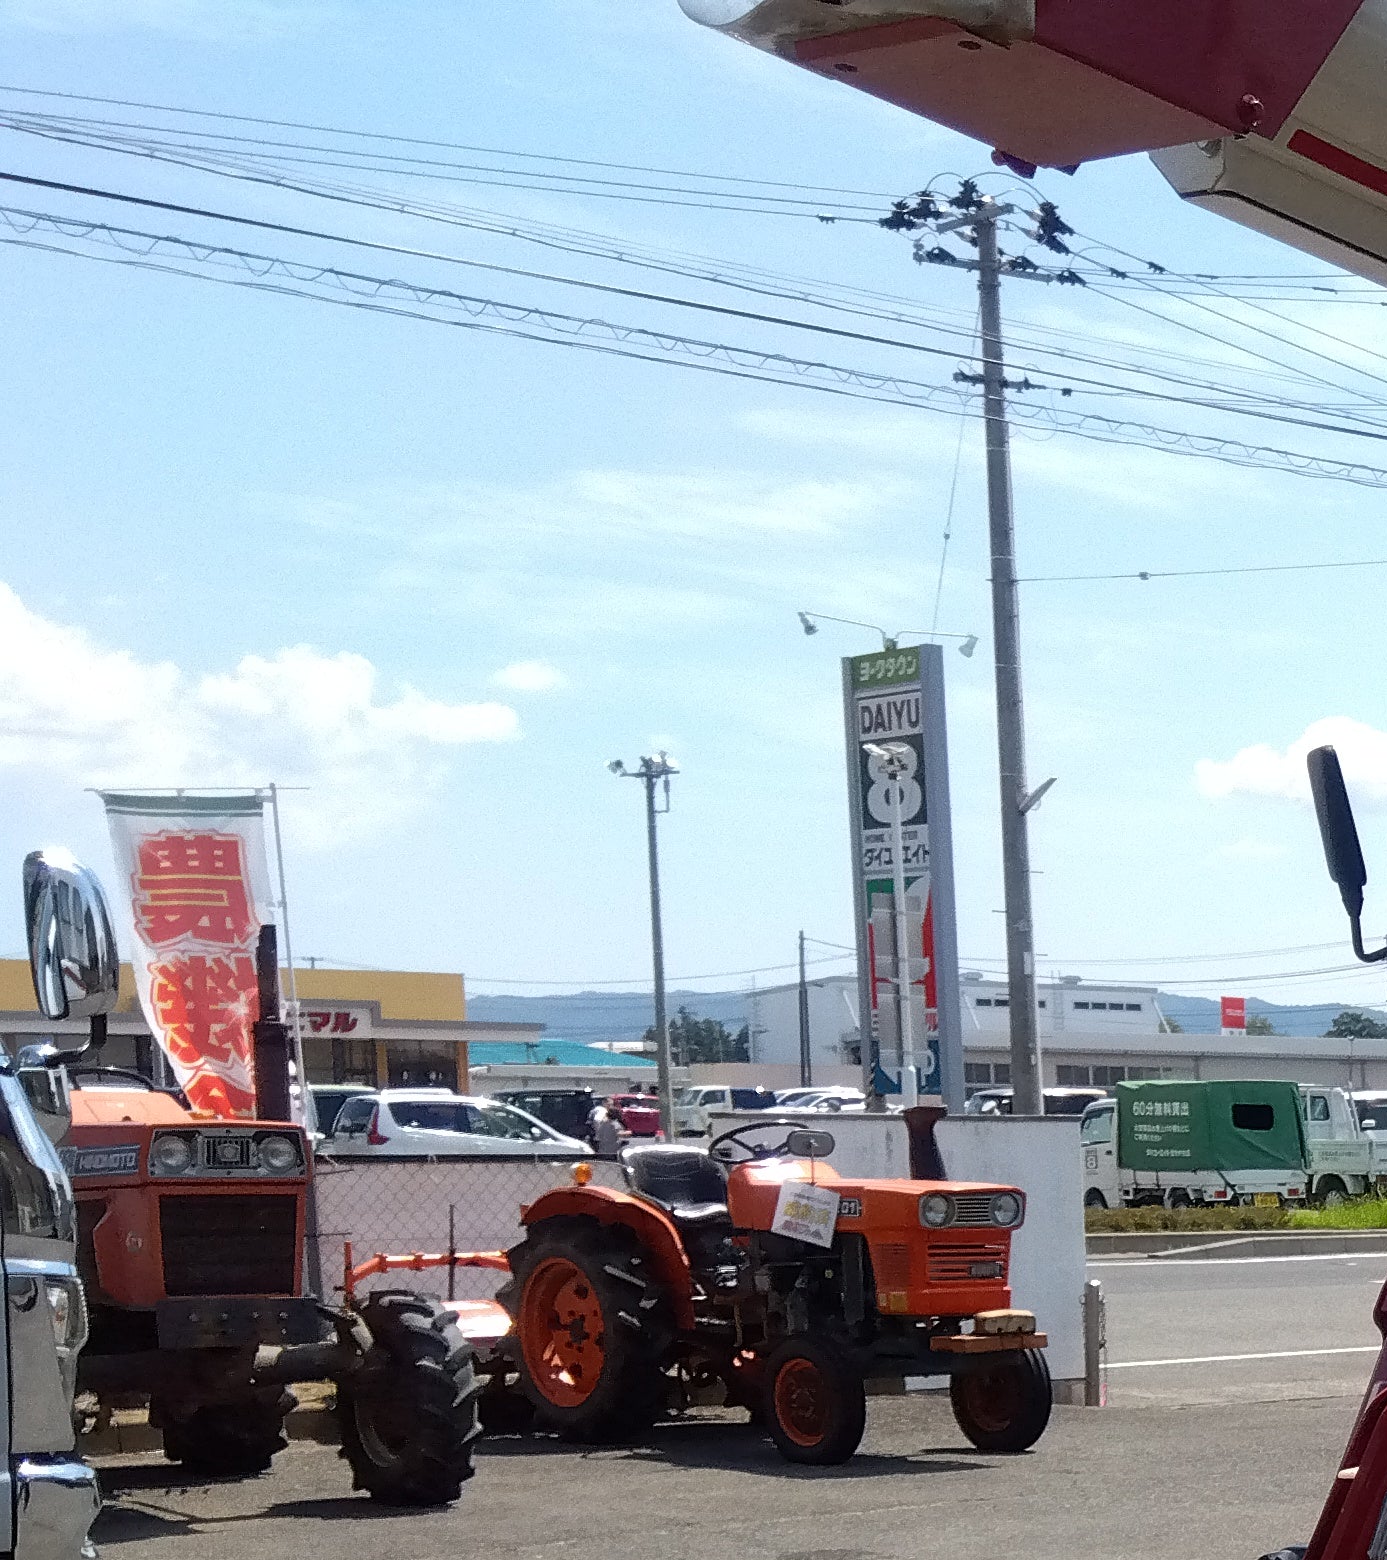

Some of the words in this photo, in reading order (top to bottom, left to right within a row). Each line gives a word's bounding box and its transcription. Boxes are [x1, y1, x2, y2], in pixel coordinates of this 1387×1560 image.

[860, 654, 919, 681] ヨークタウン
[860, 697, 920, 734] DAIYU
[864, 844, 930, 867] ダイユエイト
